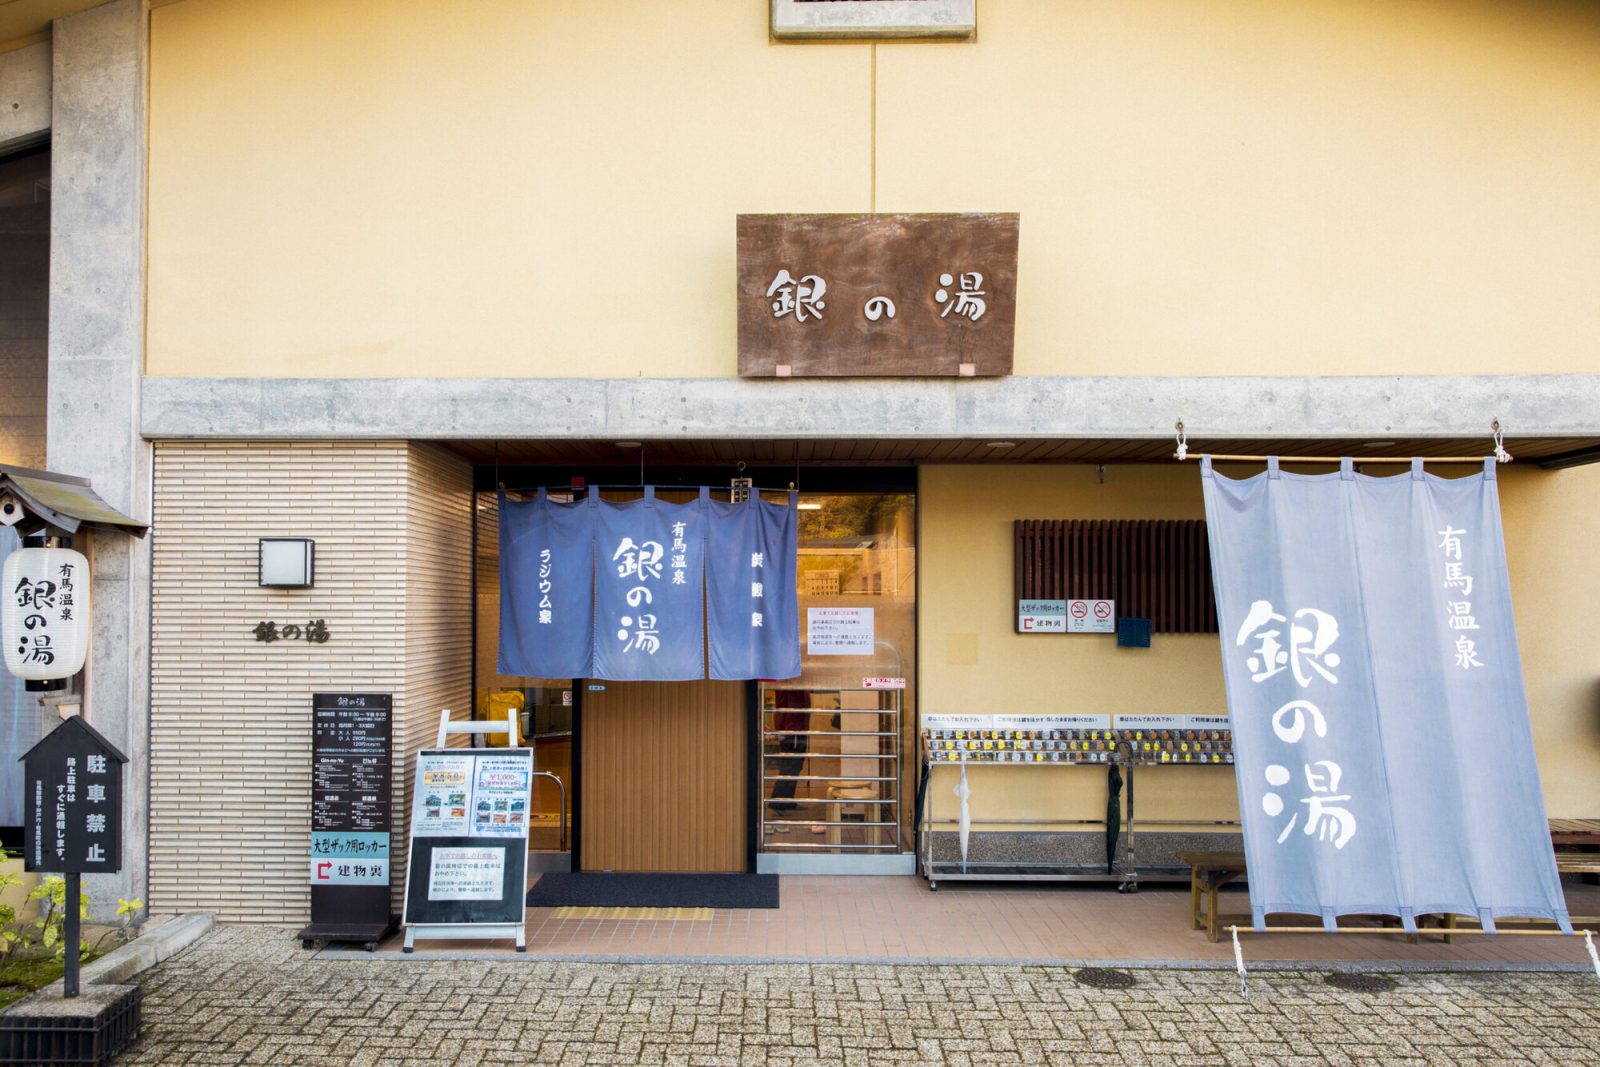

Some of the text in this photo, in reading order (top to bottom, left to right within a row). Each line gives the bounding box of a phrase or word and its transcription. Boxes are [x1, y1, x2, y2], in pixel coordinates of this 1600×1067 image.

[766, 269, 987, 323] 銀の湯
[538, 549, 553, 625] ラジウム泉
[671, 520, 687, 585] 有馬温泉
[750, 552, 764, 628] 炭酸泉
[14, 577, 57, 666] 銀の湯
[58, 562, 75, 621] 有馬温泉
[612, 537, 665, 655] 銀の湯
[1438, 526, 1485, 671] 有馬温泉
[252, 619, 331, 644] 銀の湯
[1236, 600, 1357, 850] 銀の湯
[67, 757, 77, 803] 路上駐車は
[86, 754, 106, 863] 駐車禁止
[56, 784, 66, 862] すぐに通報します。
[314, 838, 387, 854] 大型ザック用ロッカー
[337, 864, 382, 878] 建物裏
